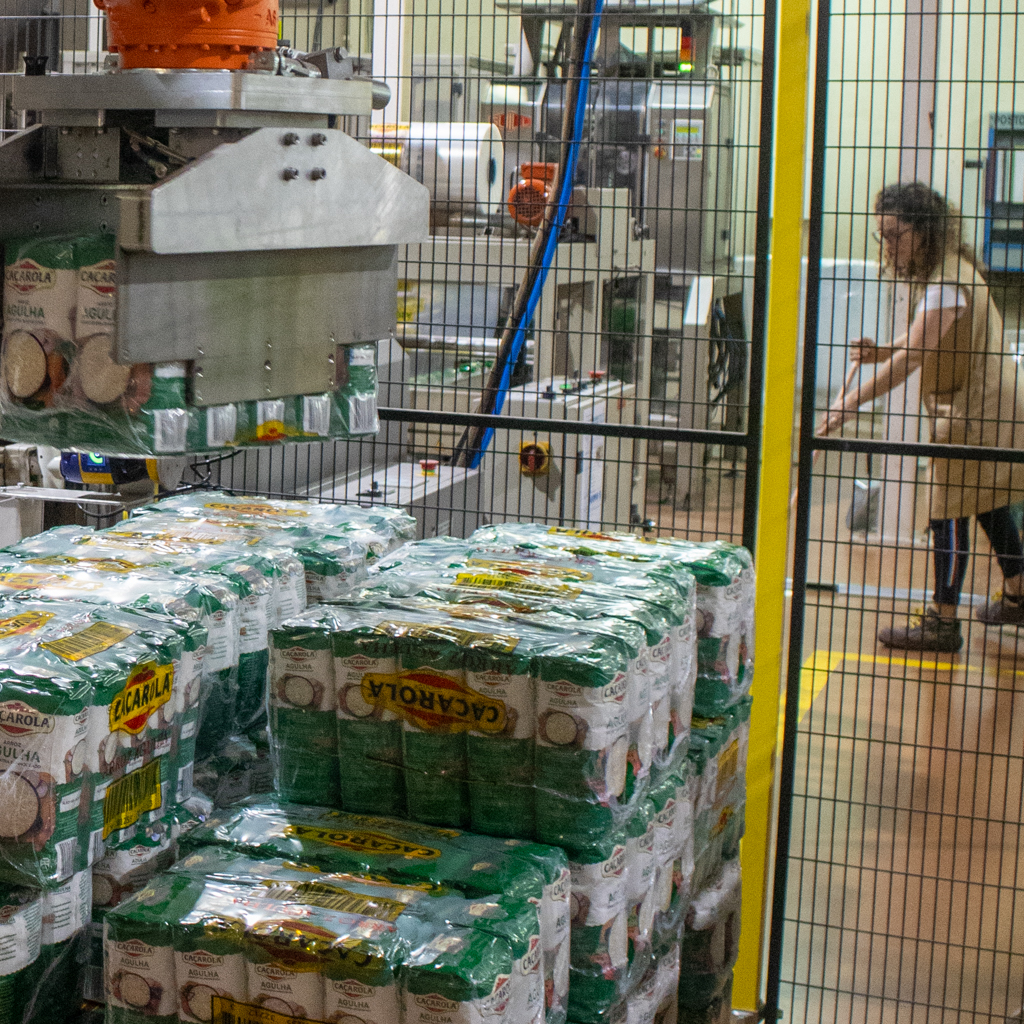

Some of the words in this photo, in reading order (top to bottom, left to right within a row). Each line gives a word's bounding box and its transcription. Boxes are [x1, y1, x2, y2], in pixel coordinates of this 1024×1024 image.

[3, 739, 22, 748] ARROZ
[120, 957, 150, 969] AGULHA
[188, 968, 219, 978] AGULHA
[260, 981, 292, 992] AGULHA
[337, 997, 370, 1009] AGULHA
[420, 1013, 453, 1024] AGULHA
